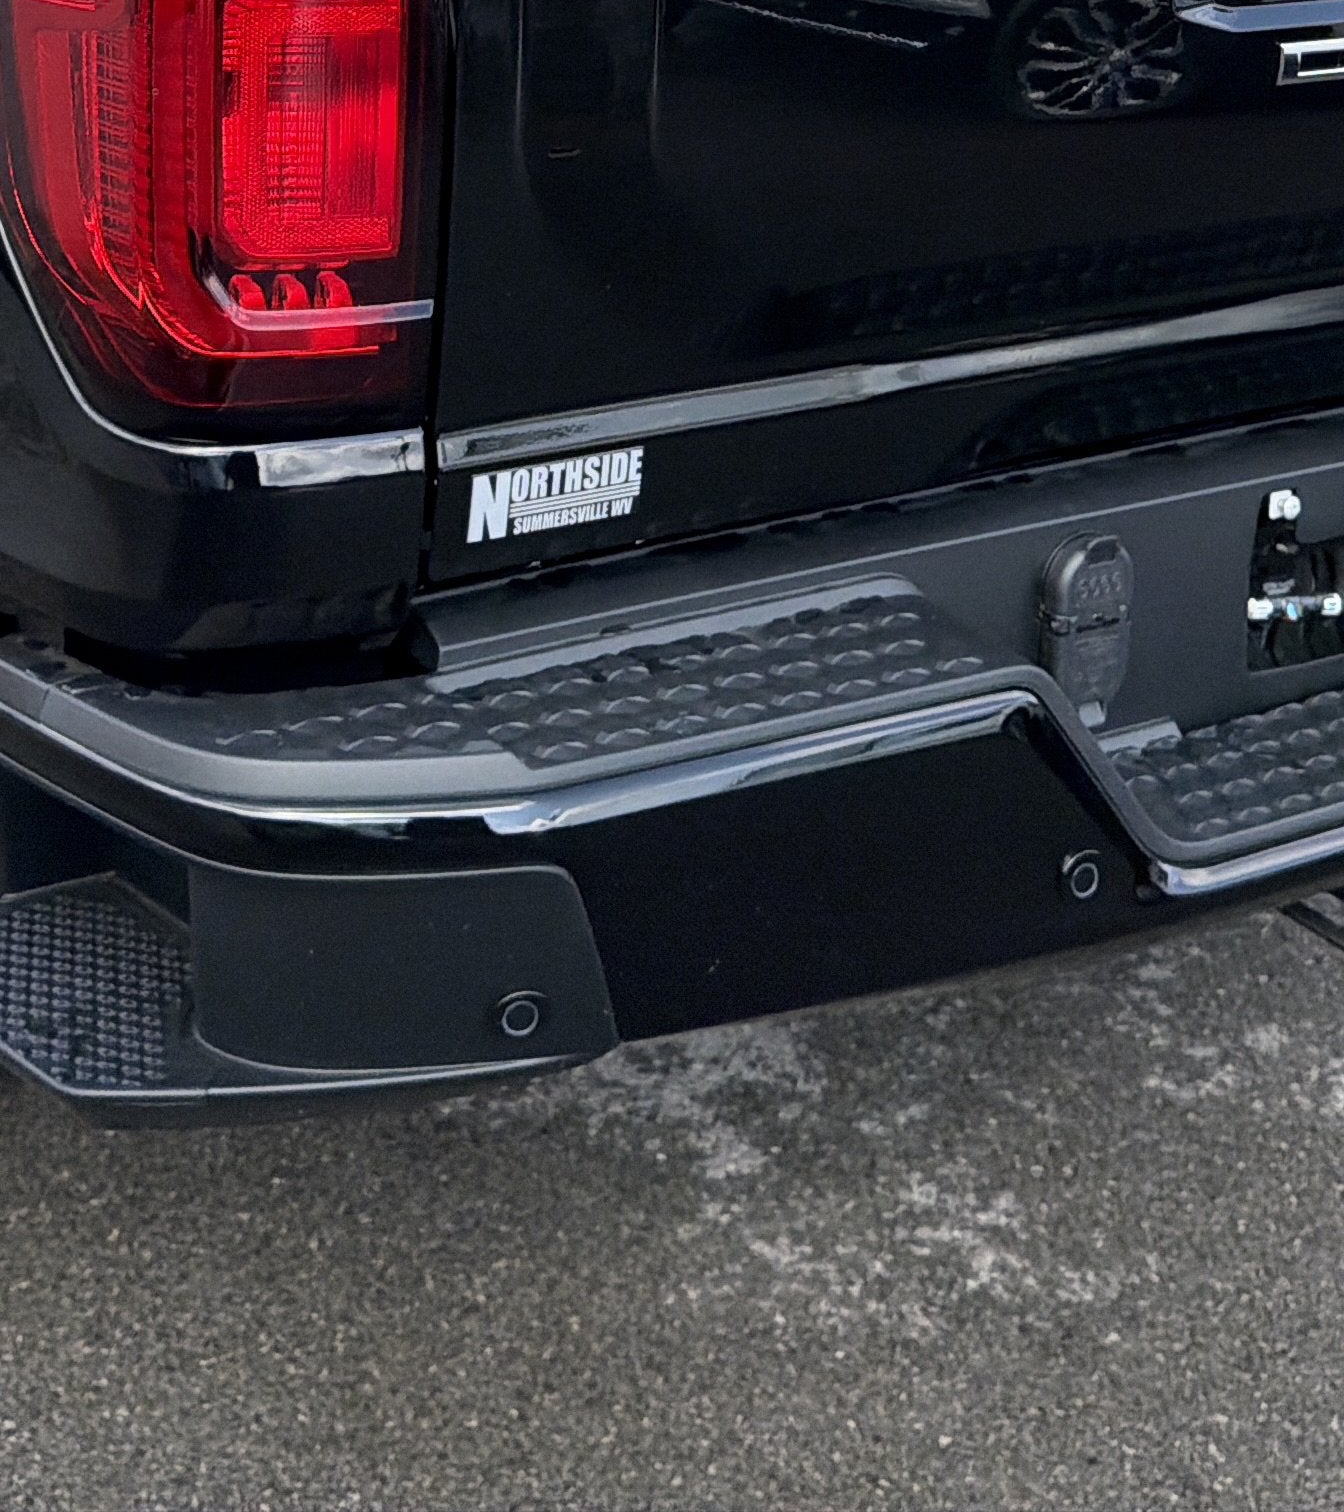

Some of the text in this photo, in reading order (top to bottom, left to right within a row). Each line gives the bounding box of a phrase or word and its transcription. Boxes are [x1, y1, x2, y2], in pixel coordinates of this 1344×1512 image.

[466, 448, 644, 544] NORTHSIDE
[513, 496, 634, 535] SUMMERSVILLE WV
